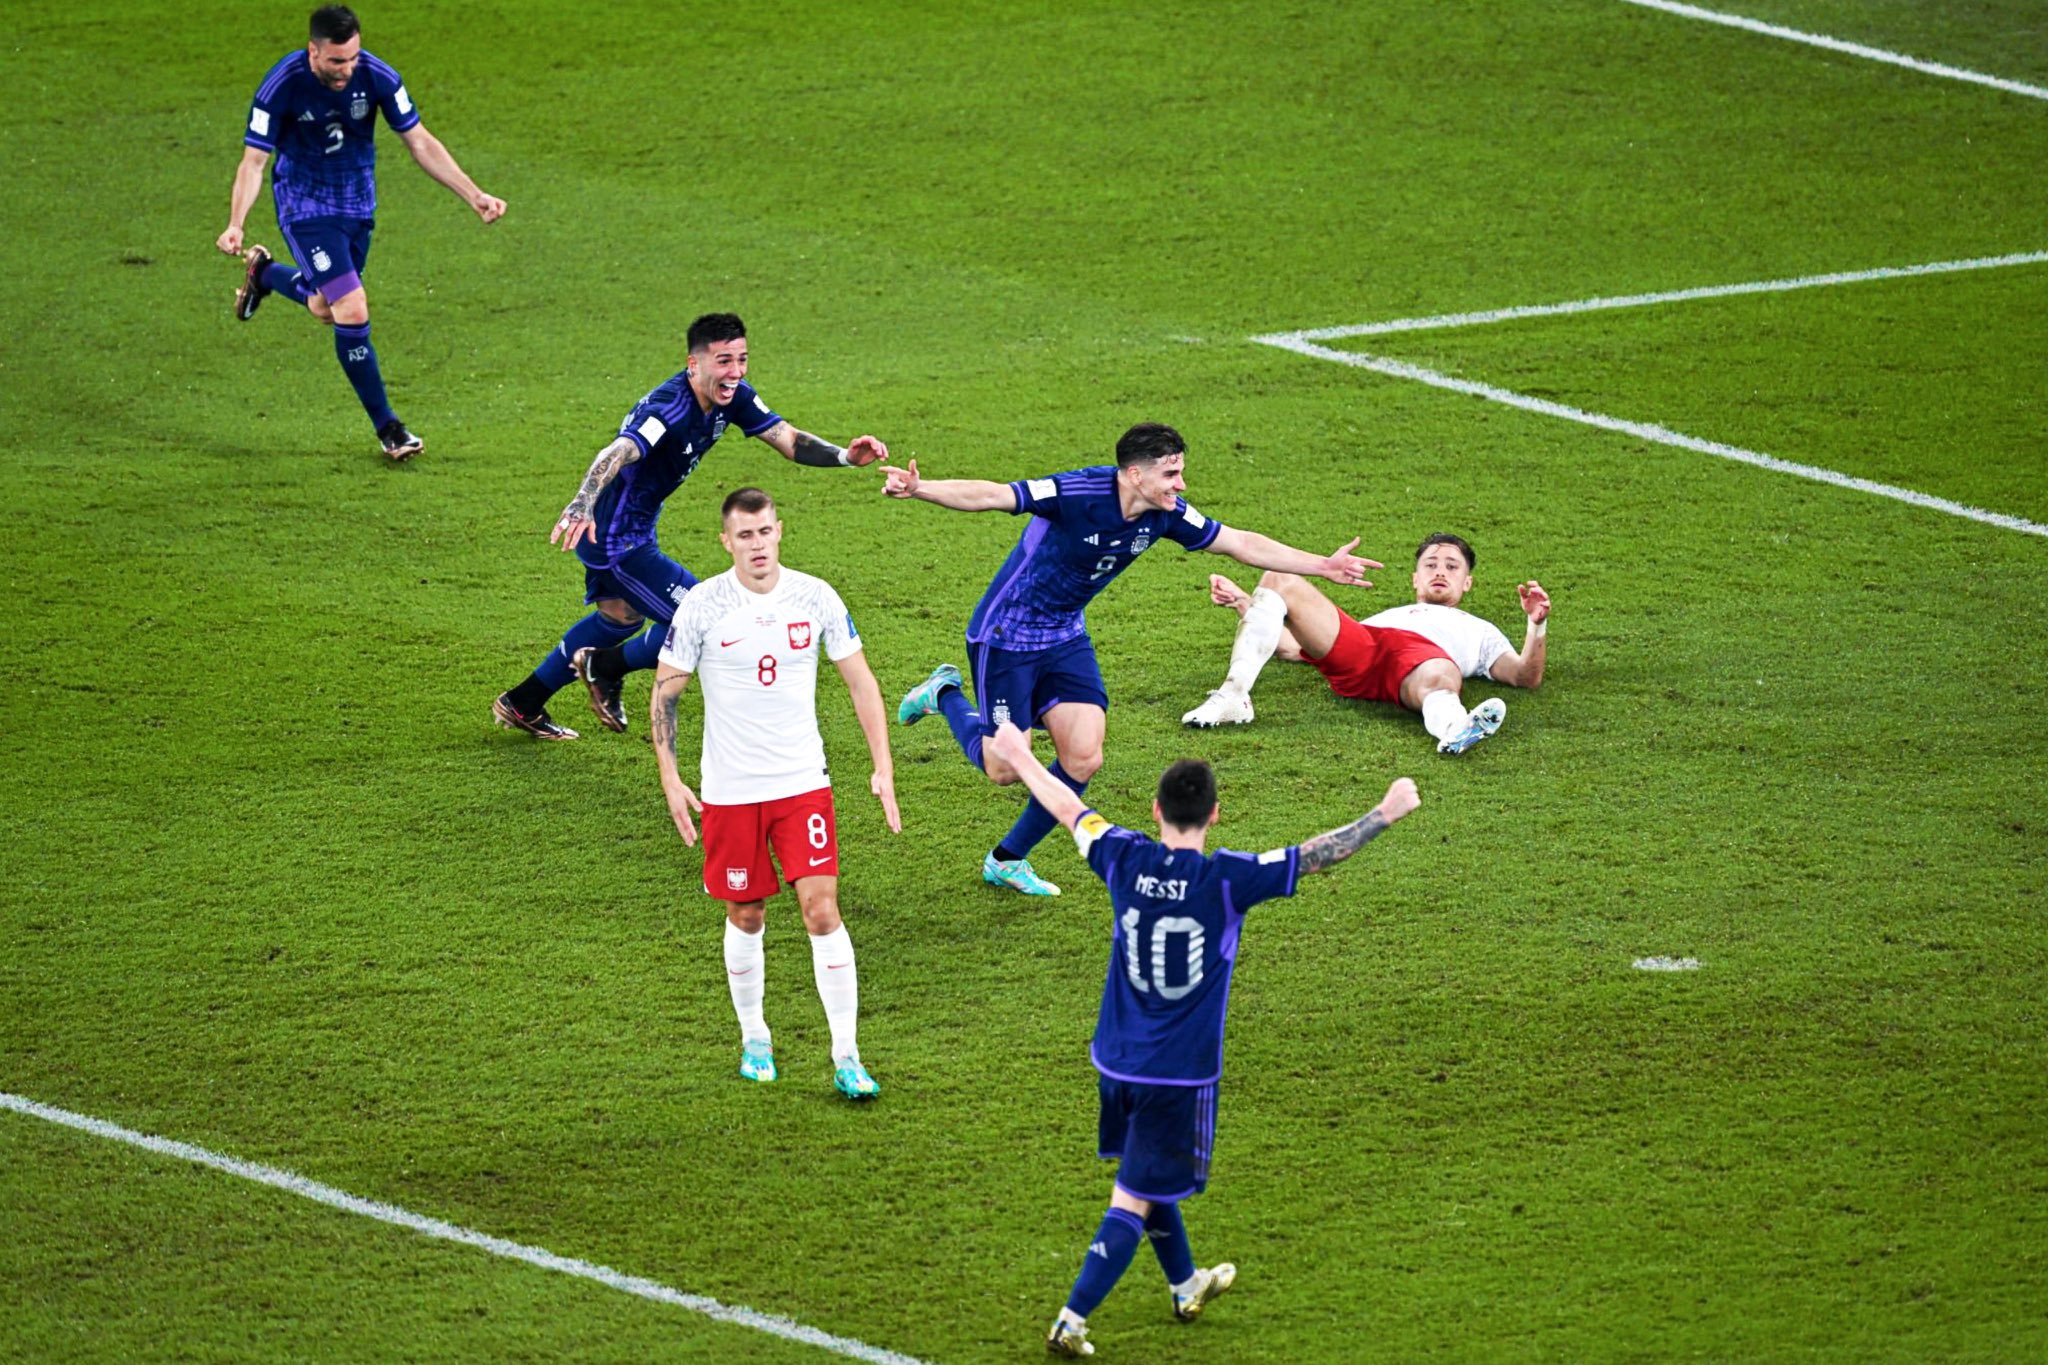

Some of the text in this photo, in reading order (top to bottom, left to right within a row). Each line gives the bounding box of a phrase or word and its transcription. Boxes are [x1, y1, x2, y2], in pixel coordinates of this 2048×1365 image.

[325, 122, 344, 154] 3
[1090, 555, 1117, 580] 9
[758, 655, 777, 686] 8
[807, 813, 828, 849] 8
[1135, 874, 1188, 902] MESSI
[1121, 906, 1206, 1001] 10
